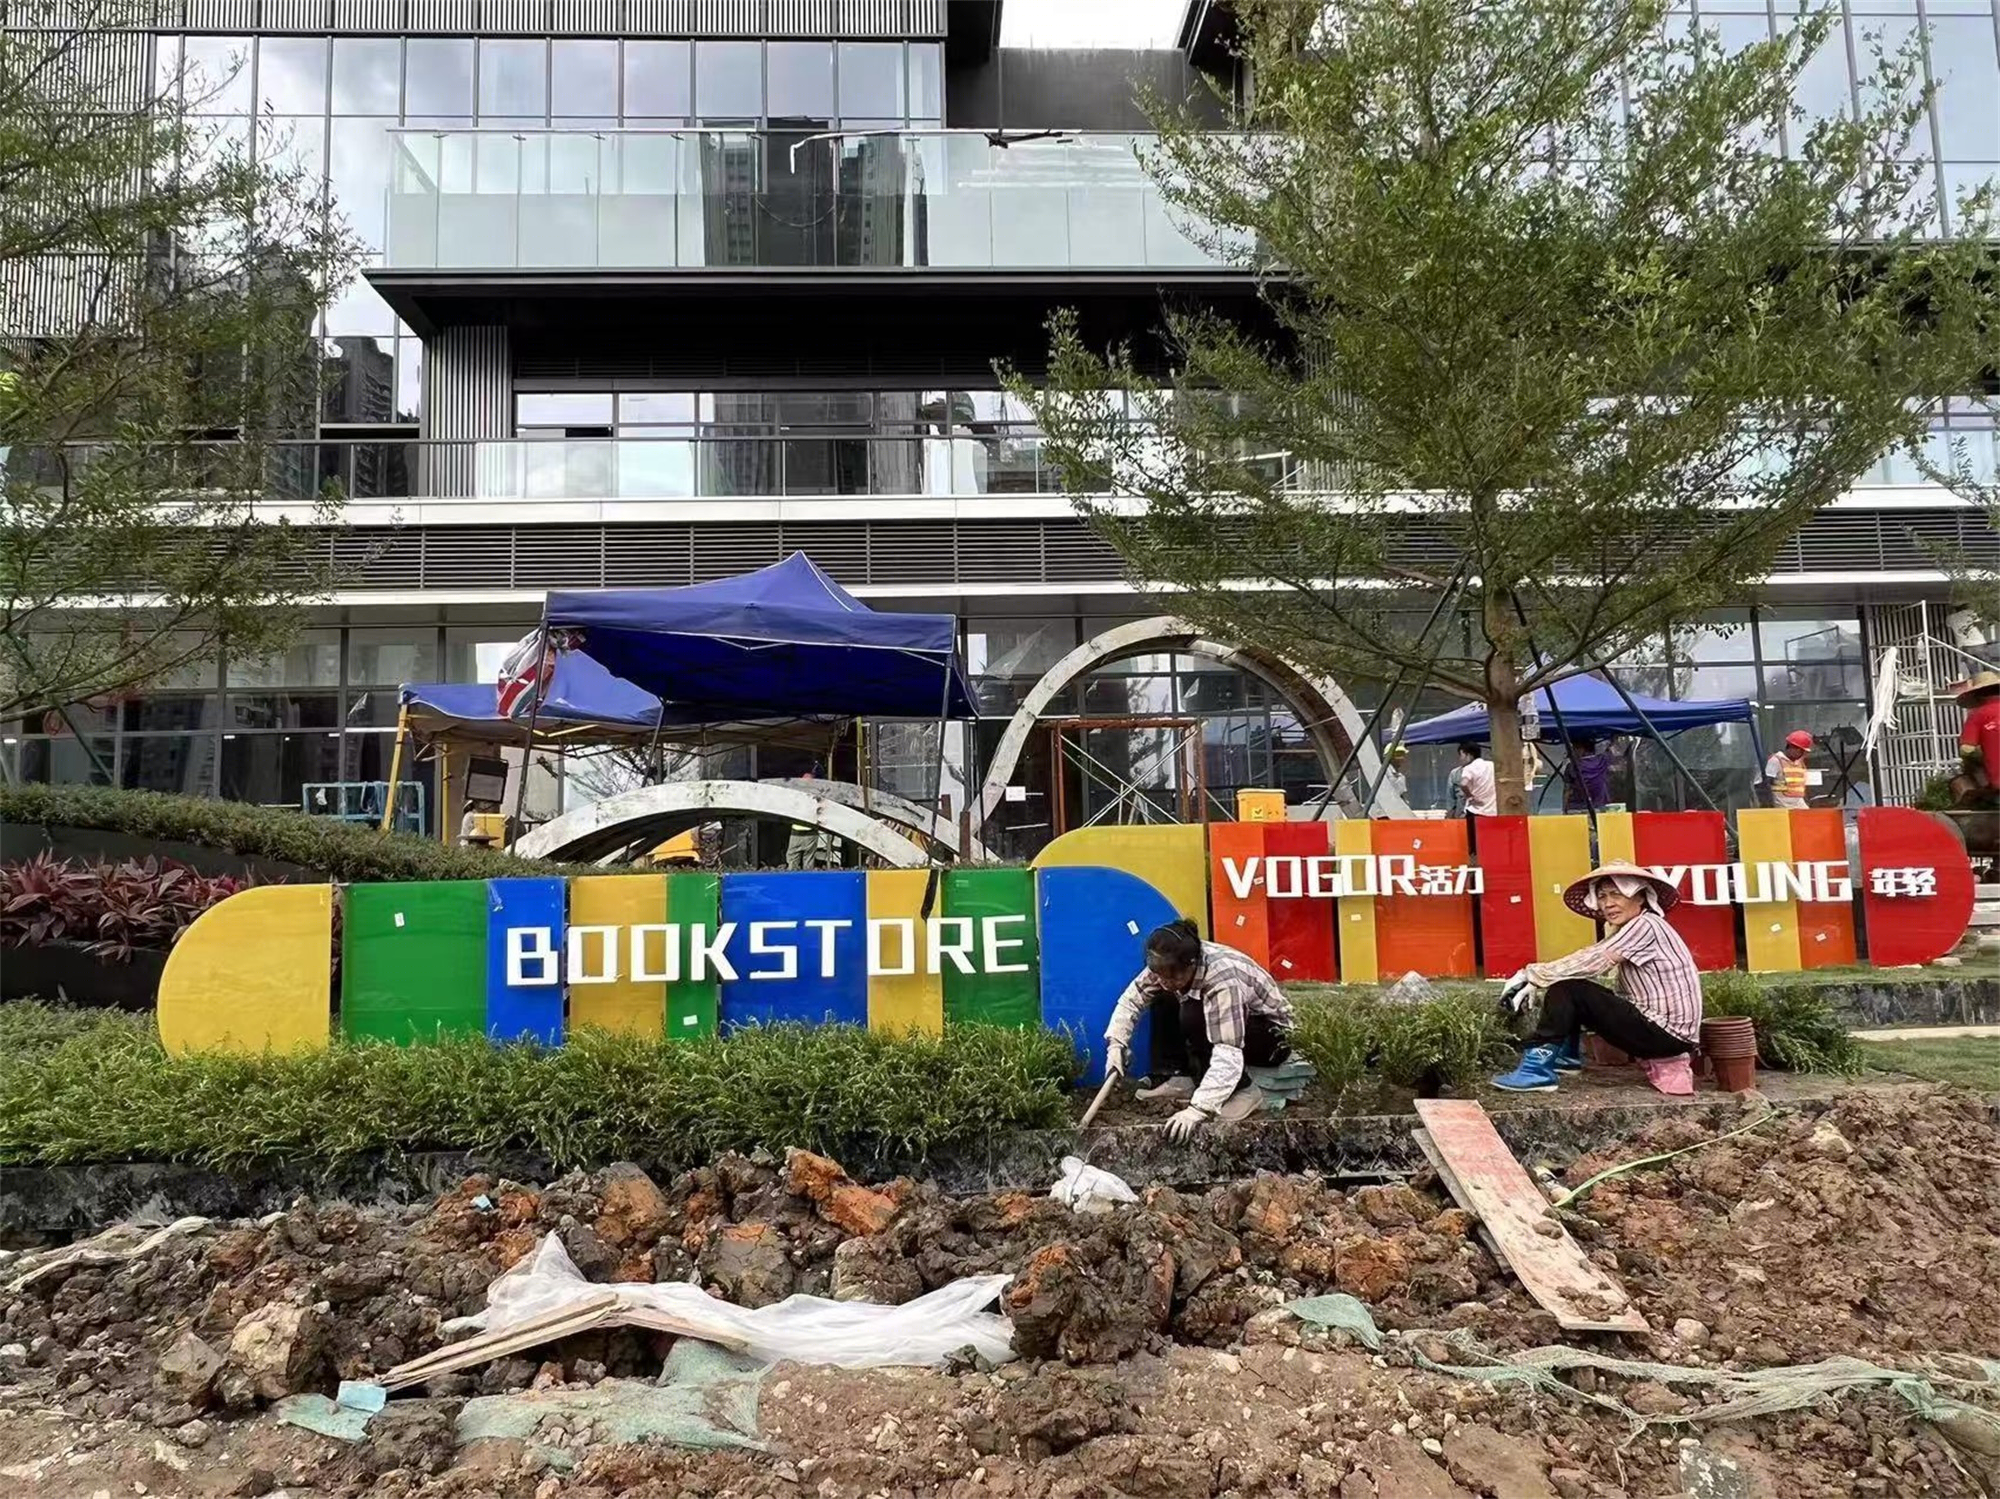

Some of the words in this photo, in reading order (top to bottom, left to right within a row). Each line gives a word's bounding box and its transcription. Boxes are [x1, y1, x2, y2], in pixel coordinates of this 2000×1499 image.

[1221, 854, 1419, 898] VOGOR
[1415, 864, 1484, 896] 活力
[1650, 860, 1853, 905] YOUNG
[1870, 867, 1938, 897] 年轻
[507, 914, 1030, 986] BOOKSTORE
